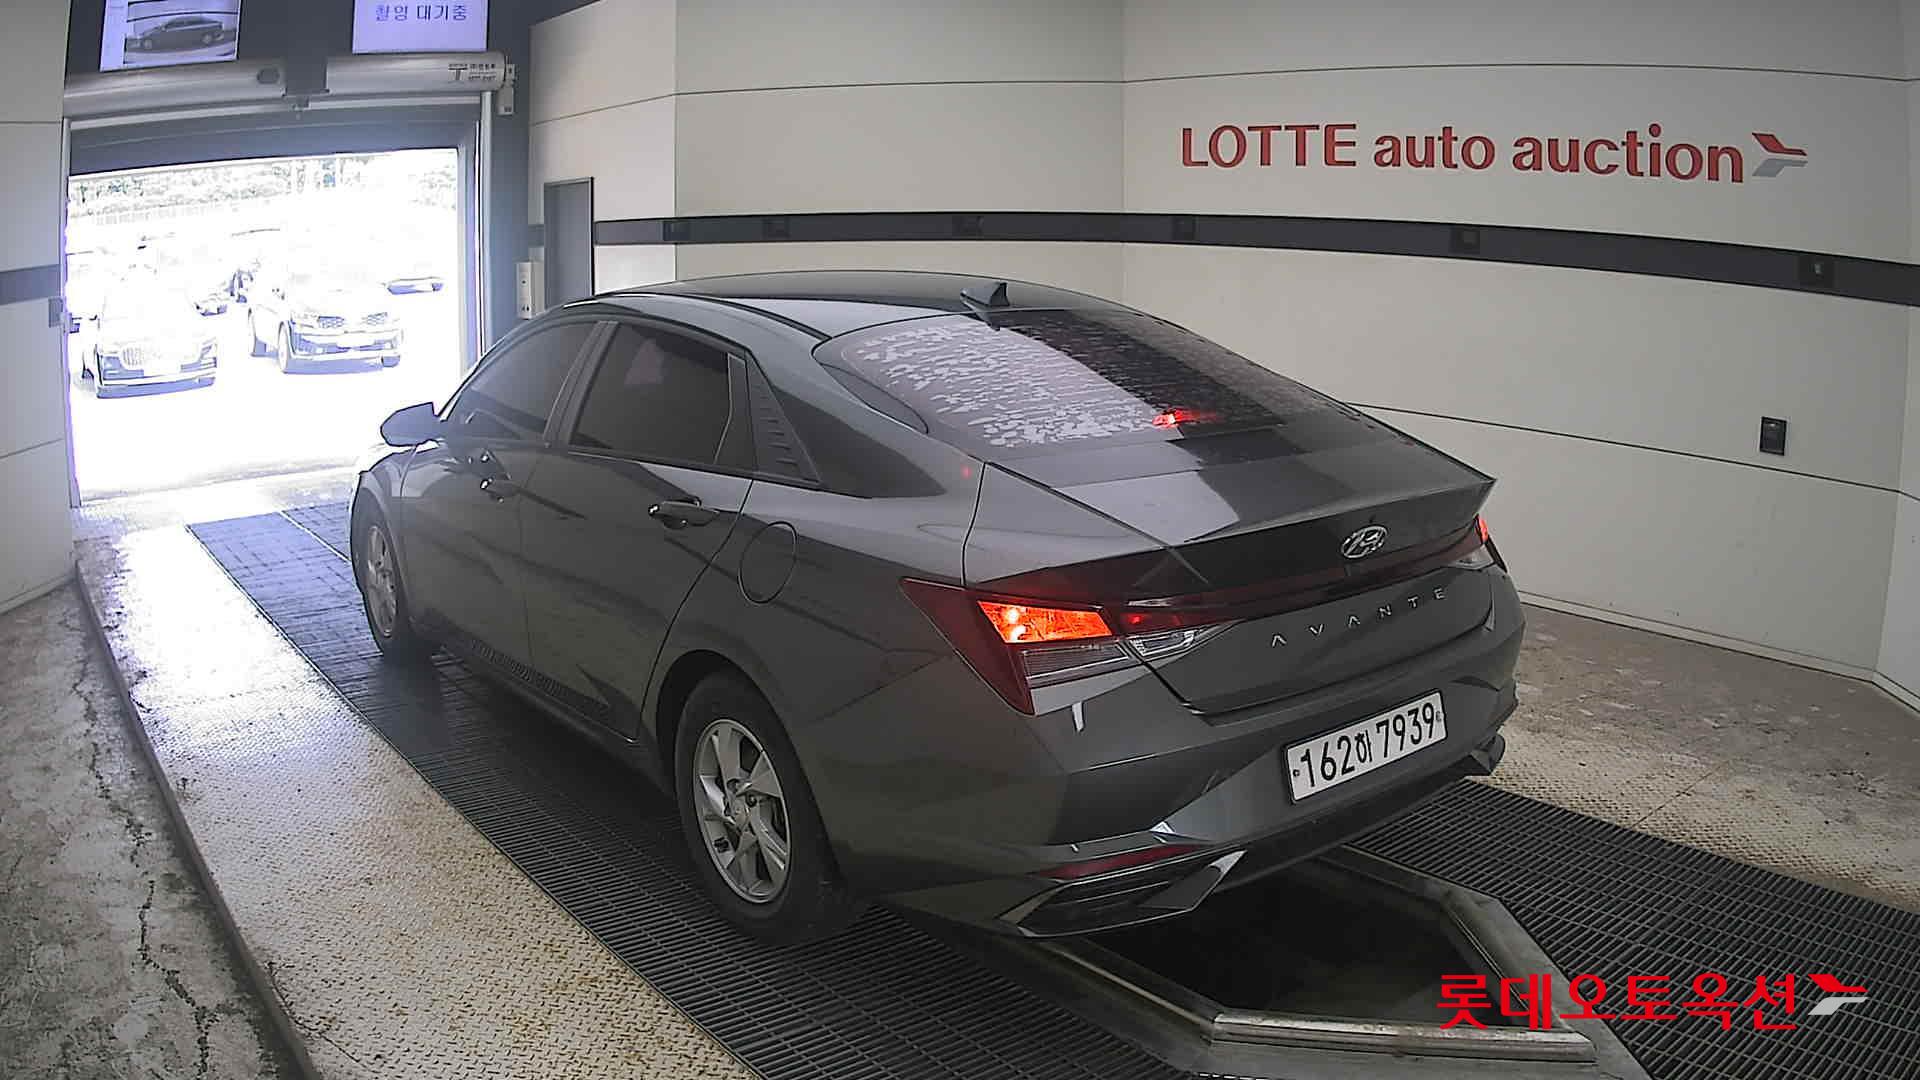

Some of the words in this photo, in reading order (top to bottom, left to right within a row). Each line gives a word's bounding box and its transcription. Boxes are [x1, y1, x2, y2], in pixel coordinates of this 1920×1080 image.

[416, 4, 467, 21] 대기중
[1182, 123, 1357, 168] LOTTE
[1373, 126, 1496, 170] auto
[1512, 123, 1745, 183] auction
[1270, 587, 1448, 648] AVANTE
